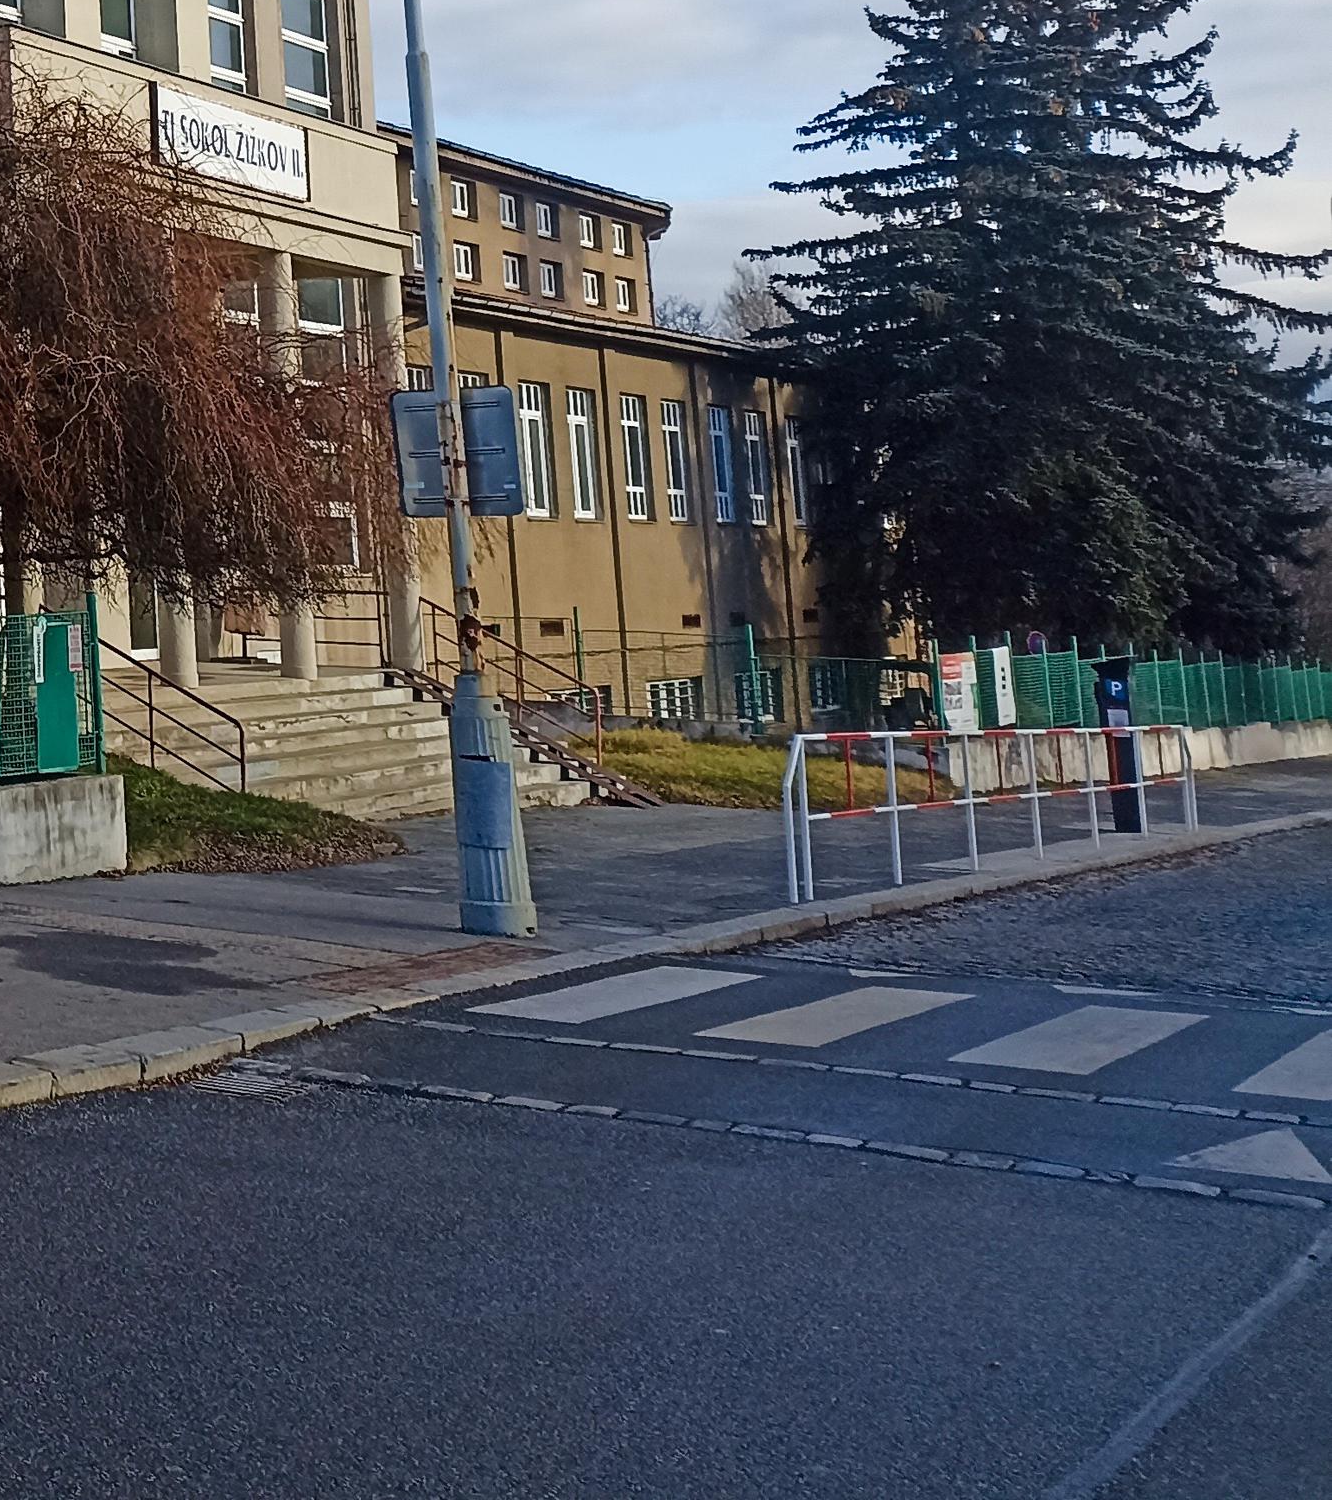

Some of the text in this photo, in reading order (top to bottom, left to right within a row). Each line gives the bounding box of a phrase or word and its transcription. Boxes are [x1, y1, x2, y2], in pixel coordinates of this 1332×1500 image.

[180, 114, 231, 158] SOKOL
[236, 124, 288, 173] ŽIŽKOV
[292, 148, 305, 179] II.
[1111, 680, 1123, 696] P
